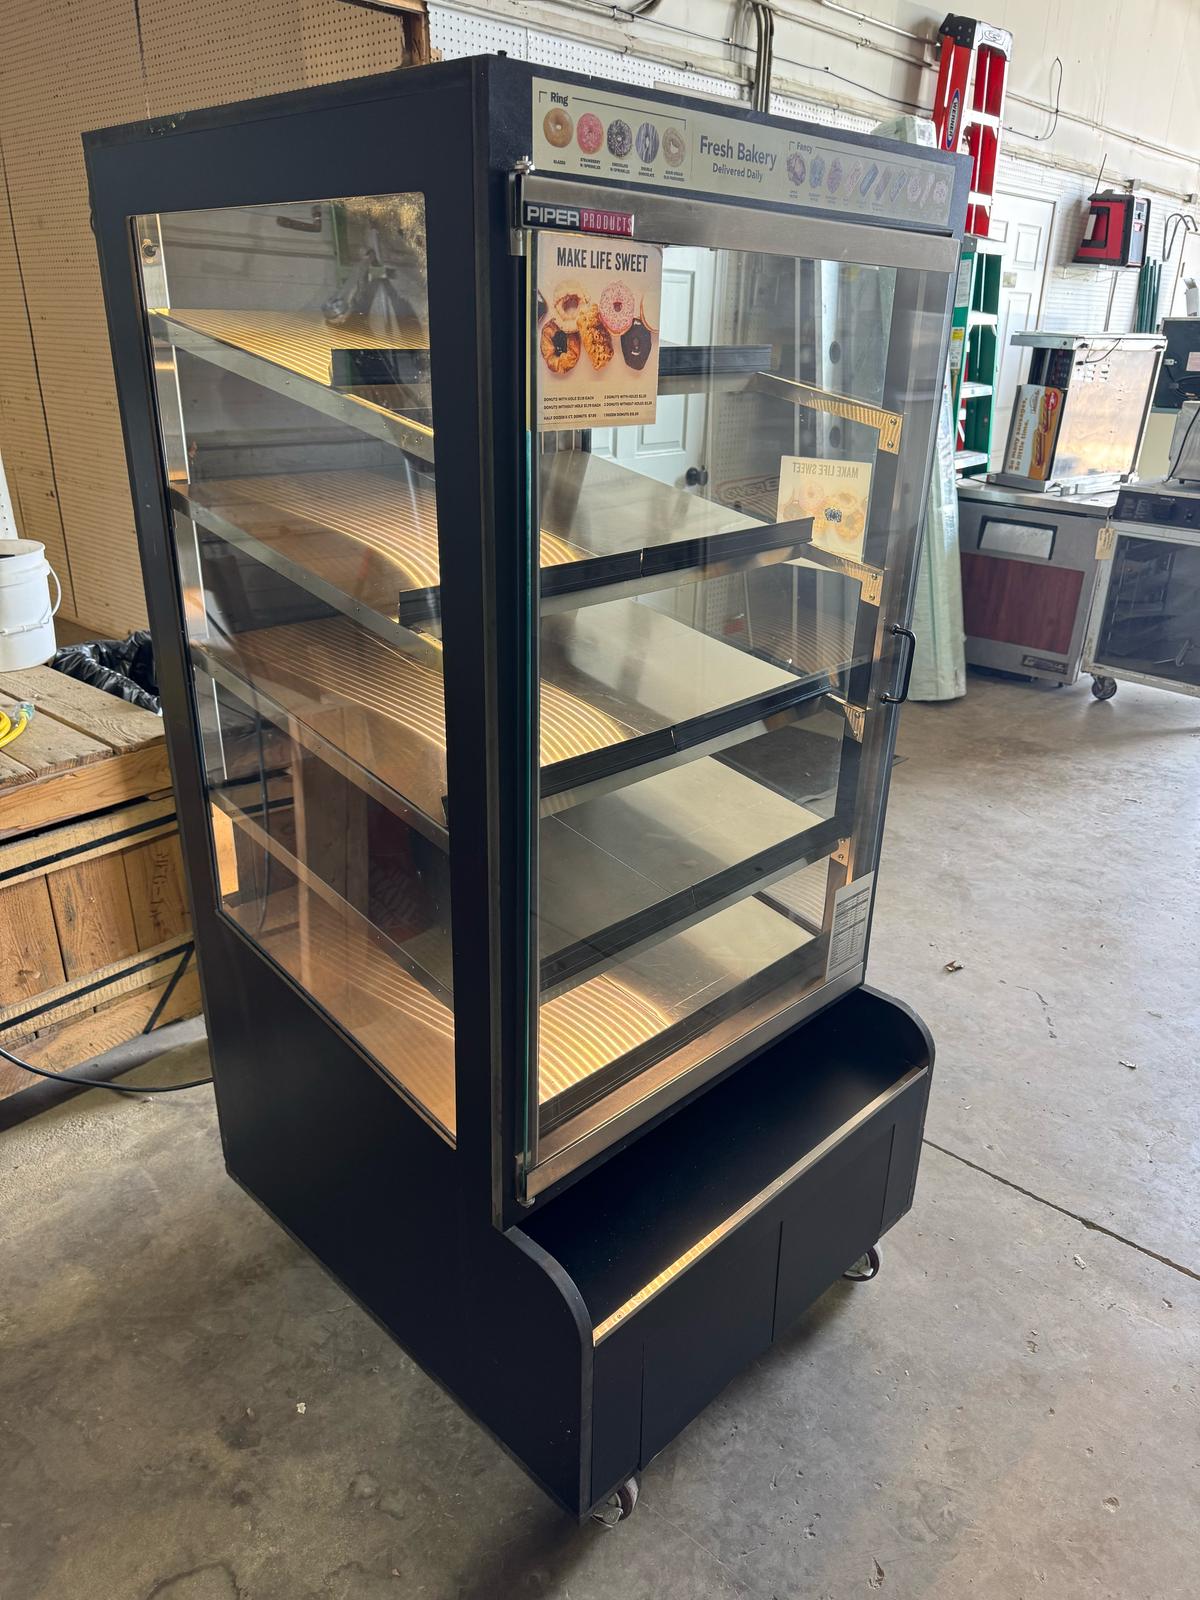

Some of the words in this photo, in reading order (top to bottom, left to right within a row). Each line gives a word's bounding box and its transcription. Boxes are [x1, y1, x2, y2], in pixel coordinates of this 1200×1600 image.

[550, 91, 569, 107] Ring
[949, 101, 958, 137] WERNER
[700, 135, 733, 159] Fresh
[737, 142, 777, 171] Bakery
[796, 141, 813, 154] Fancy
[712, 162, 746, 178] Delivered
[747, 168, 764, 183] Daily
[527, 205, 580, 227] PIPER
[583, 212, 633, 233] PRODUCTS
[557, 247, 587, 268] MAKE
[590, 250, 612, 270] LIFE
[614, 254, 649, 273] SWEET
